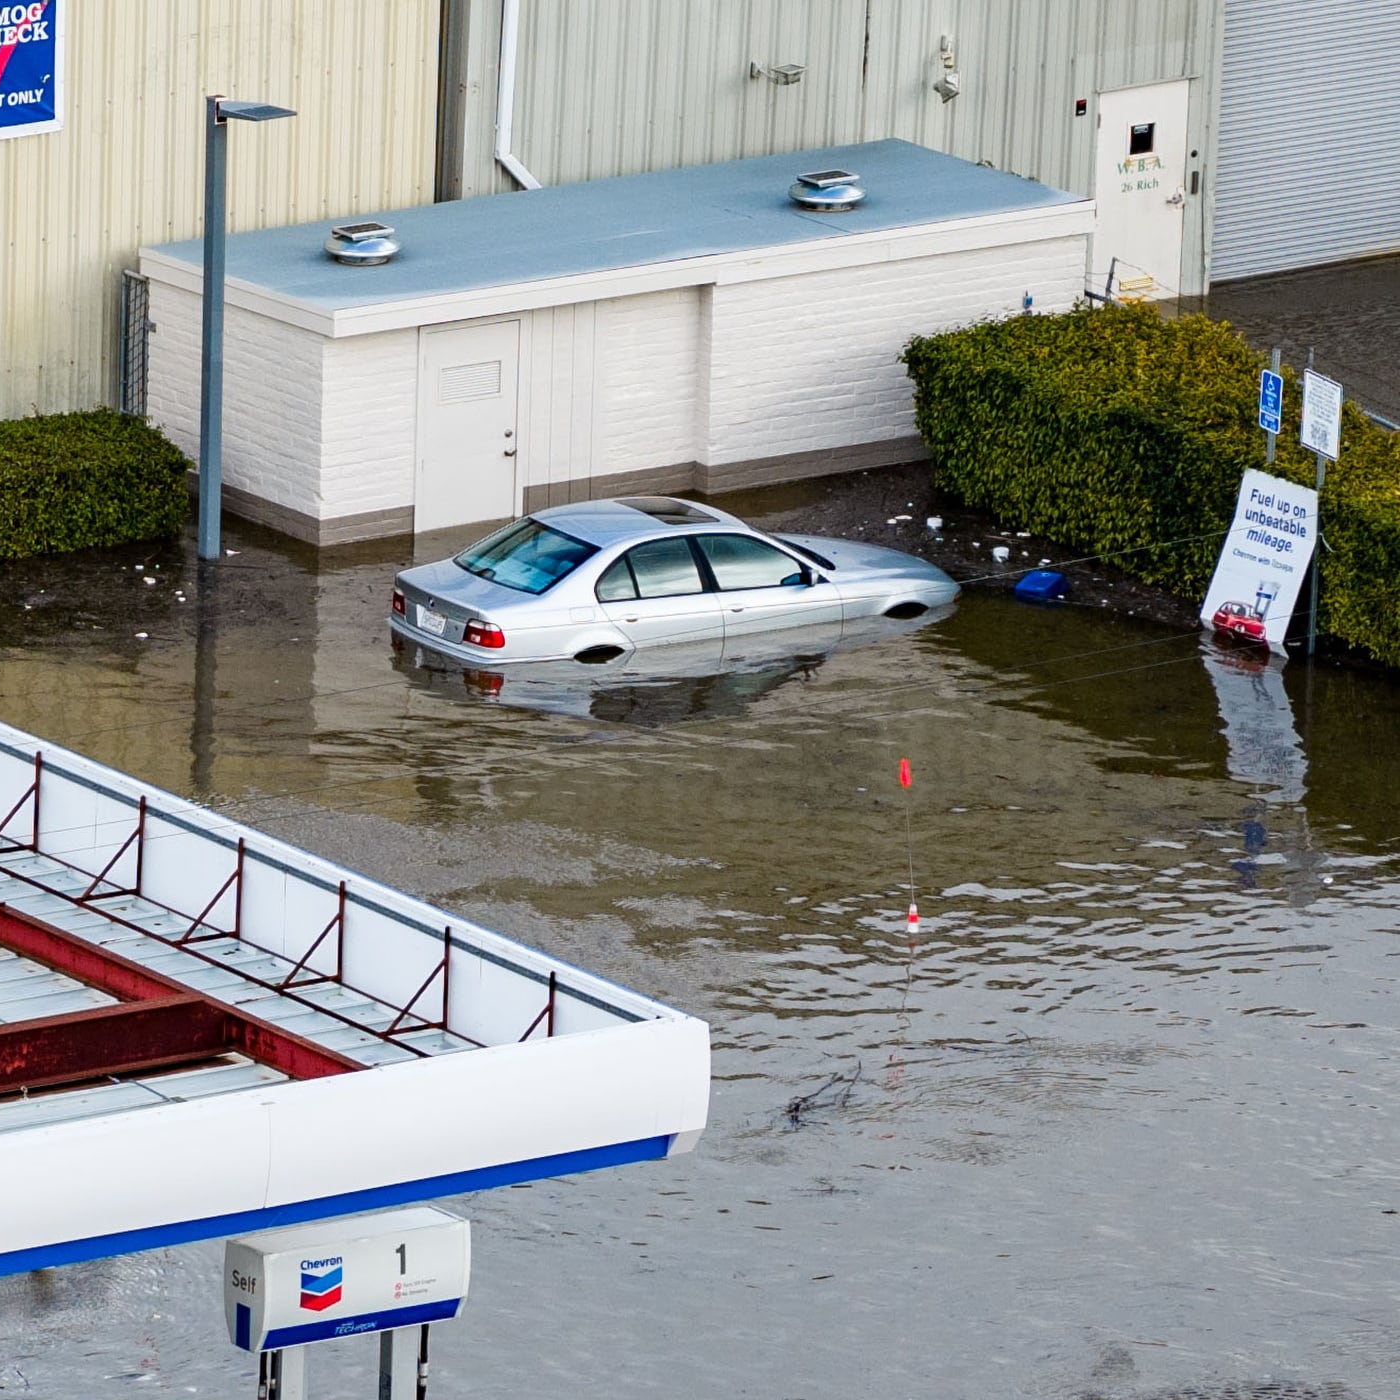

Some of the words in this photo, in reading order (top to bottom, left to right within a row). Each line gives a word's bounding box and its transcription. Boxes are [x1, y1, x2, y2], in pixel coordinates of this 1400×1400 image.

[7, 89, 44, 106] ONLY
[1121, 181, 1133, 193] 26
[1136, 178, 1159, 191] Rich
[1250, 488, 1276, 508] Fuel
[1277, 502, 1290, 515] up
[1293, 505, 1307, 519] on
[1245, 509, 1307, 538] unbeatable
[300, 1256, 343, 1272] Chevron
[395, 1243, 407, 1275] 1
[232, 1270, 257, 1295] Self
